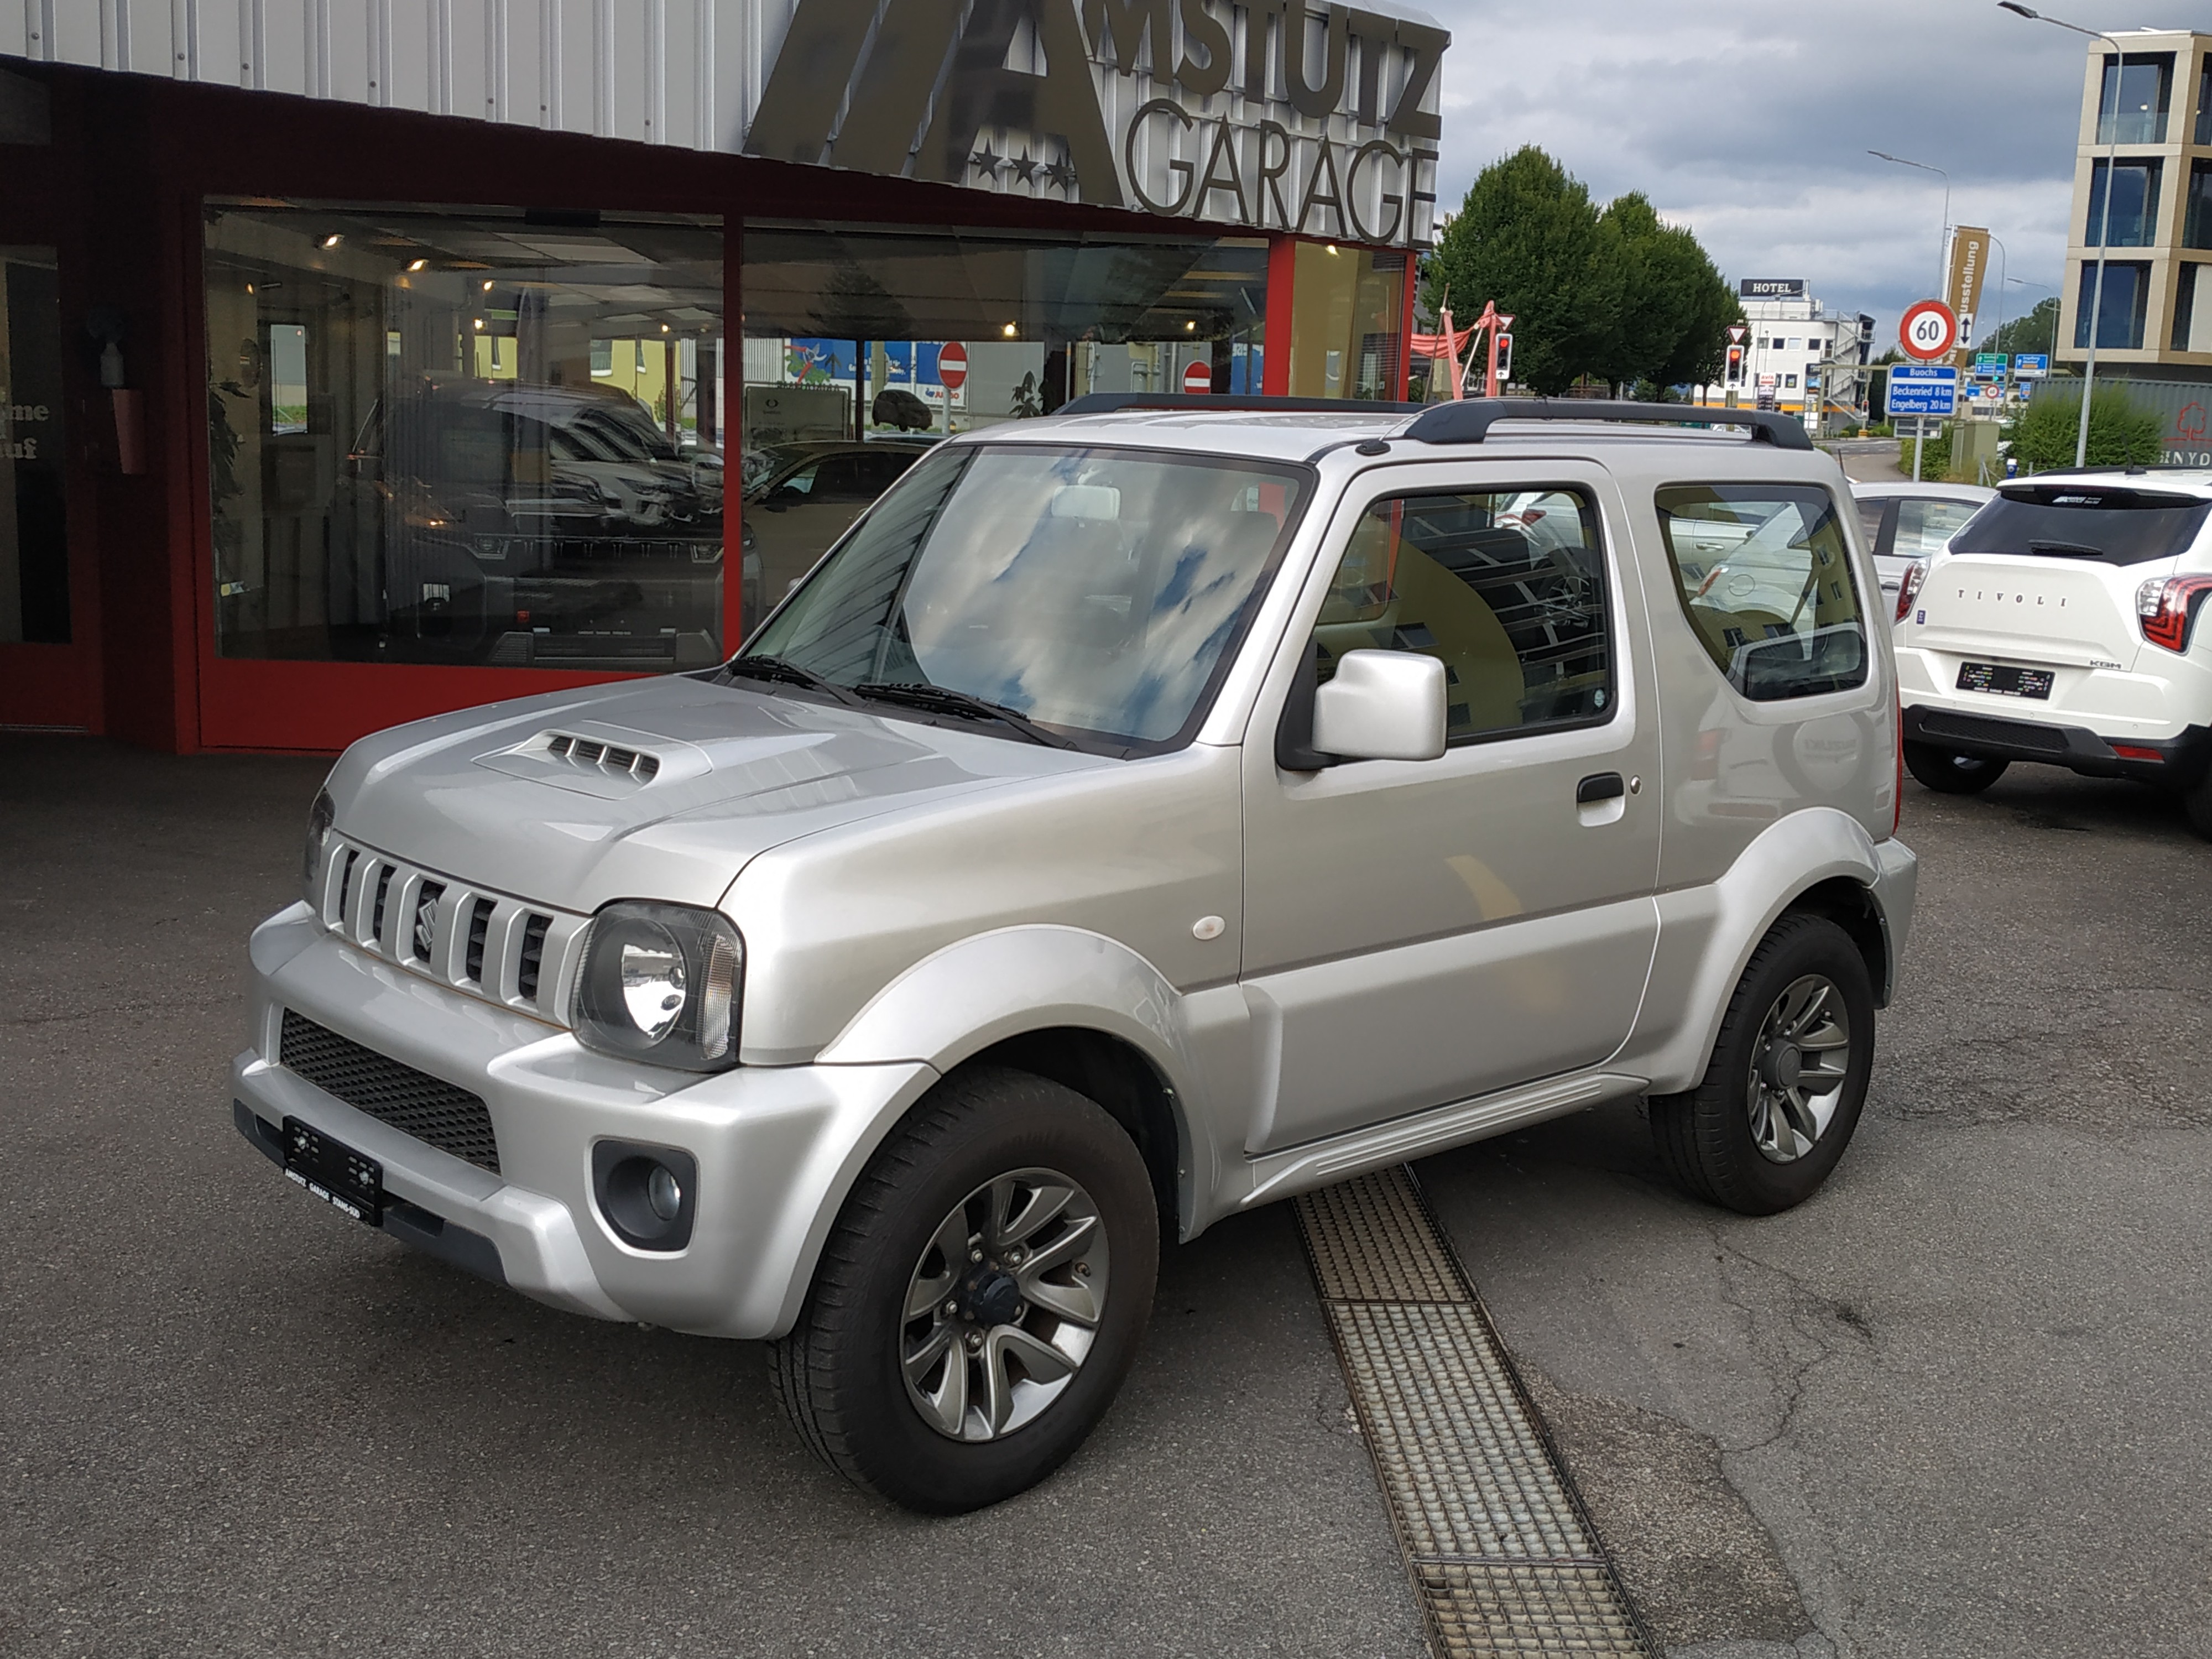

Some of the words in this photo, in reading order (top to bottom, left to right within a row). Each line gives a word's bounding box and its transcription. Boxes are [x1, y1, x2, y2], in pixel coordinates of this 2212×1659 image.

[1126, 98, 1439, 249] GARAGE
[1752, 283, 1791, 293] HOTEL
[1959, 241, 1979, 319] usstellung
[1917, 320, 1939, 341] 60
[1910, 368, 1938, 377] Buochs
[1892, 386, 1932, 397] Beckenried
[1935, 387, 1940, 397] 8
[1941, 387, 1952, 397] km
[1891, 399, 1928, 411] Engelberg
[1930, 400, 1939, 410] 20
[1940, 400, 1951, 410] km
[1958, 589, 2066, 607] TIVOLI
[309, 1182, 330, 1201] GARAGE
